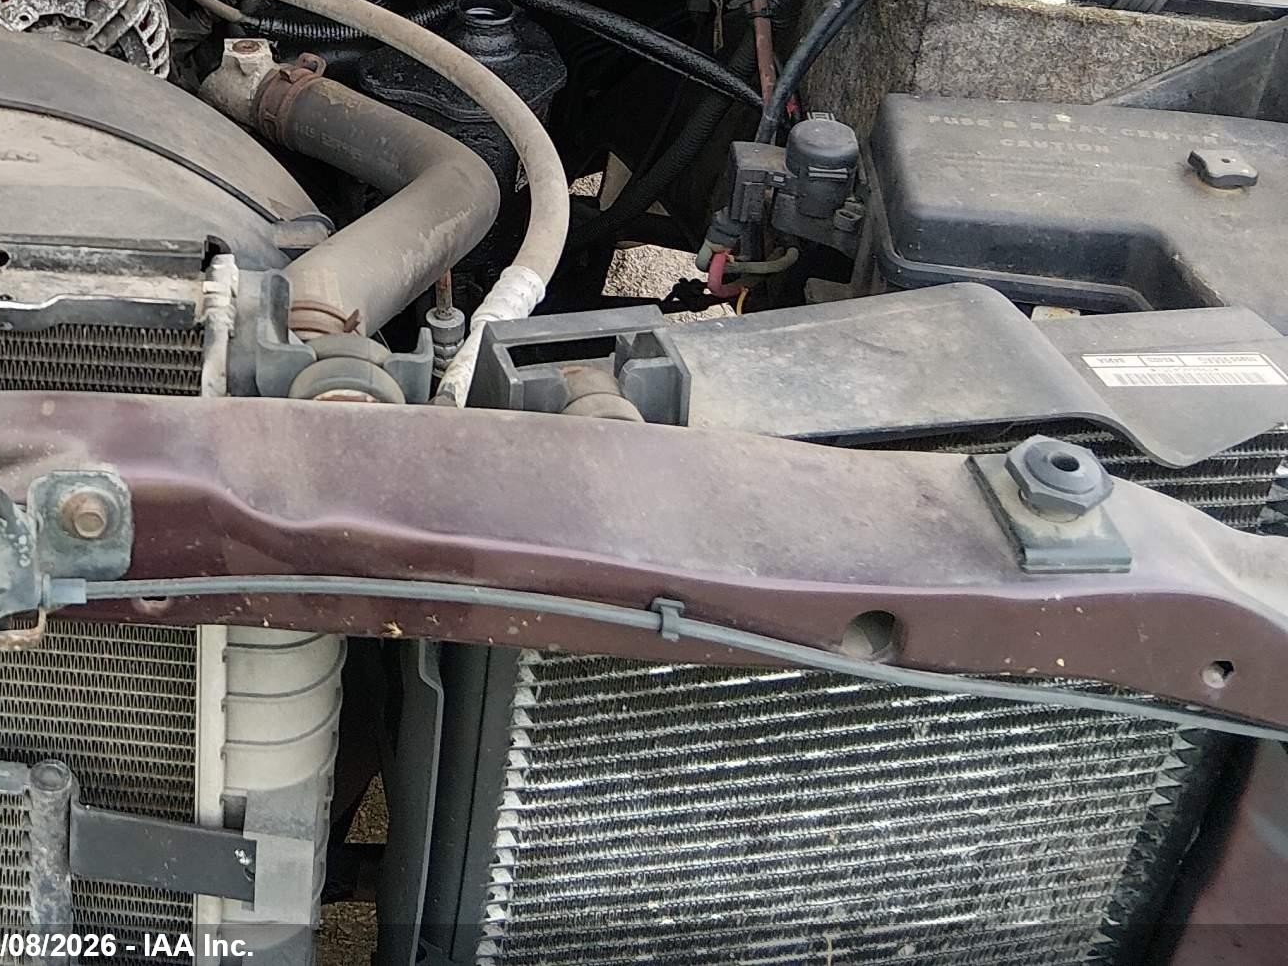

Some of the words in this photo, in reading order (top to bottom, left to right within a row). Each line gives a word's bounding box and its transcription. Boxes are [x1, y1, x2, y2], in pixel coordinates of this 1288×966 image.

[928, 115, 992, 129] FUSE
[1119, 128, 1220, 145] CENTER
[999, 138, 1111, 154] CAUTION
